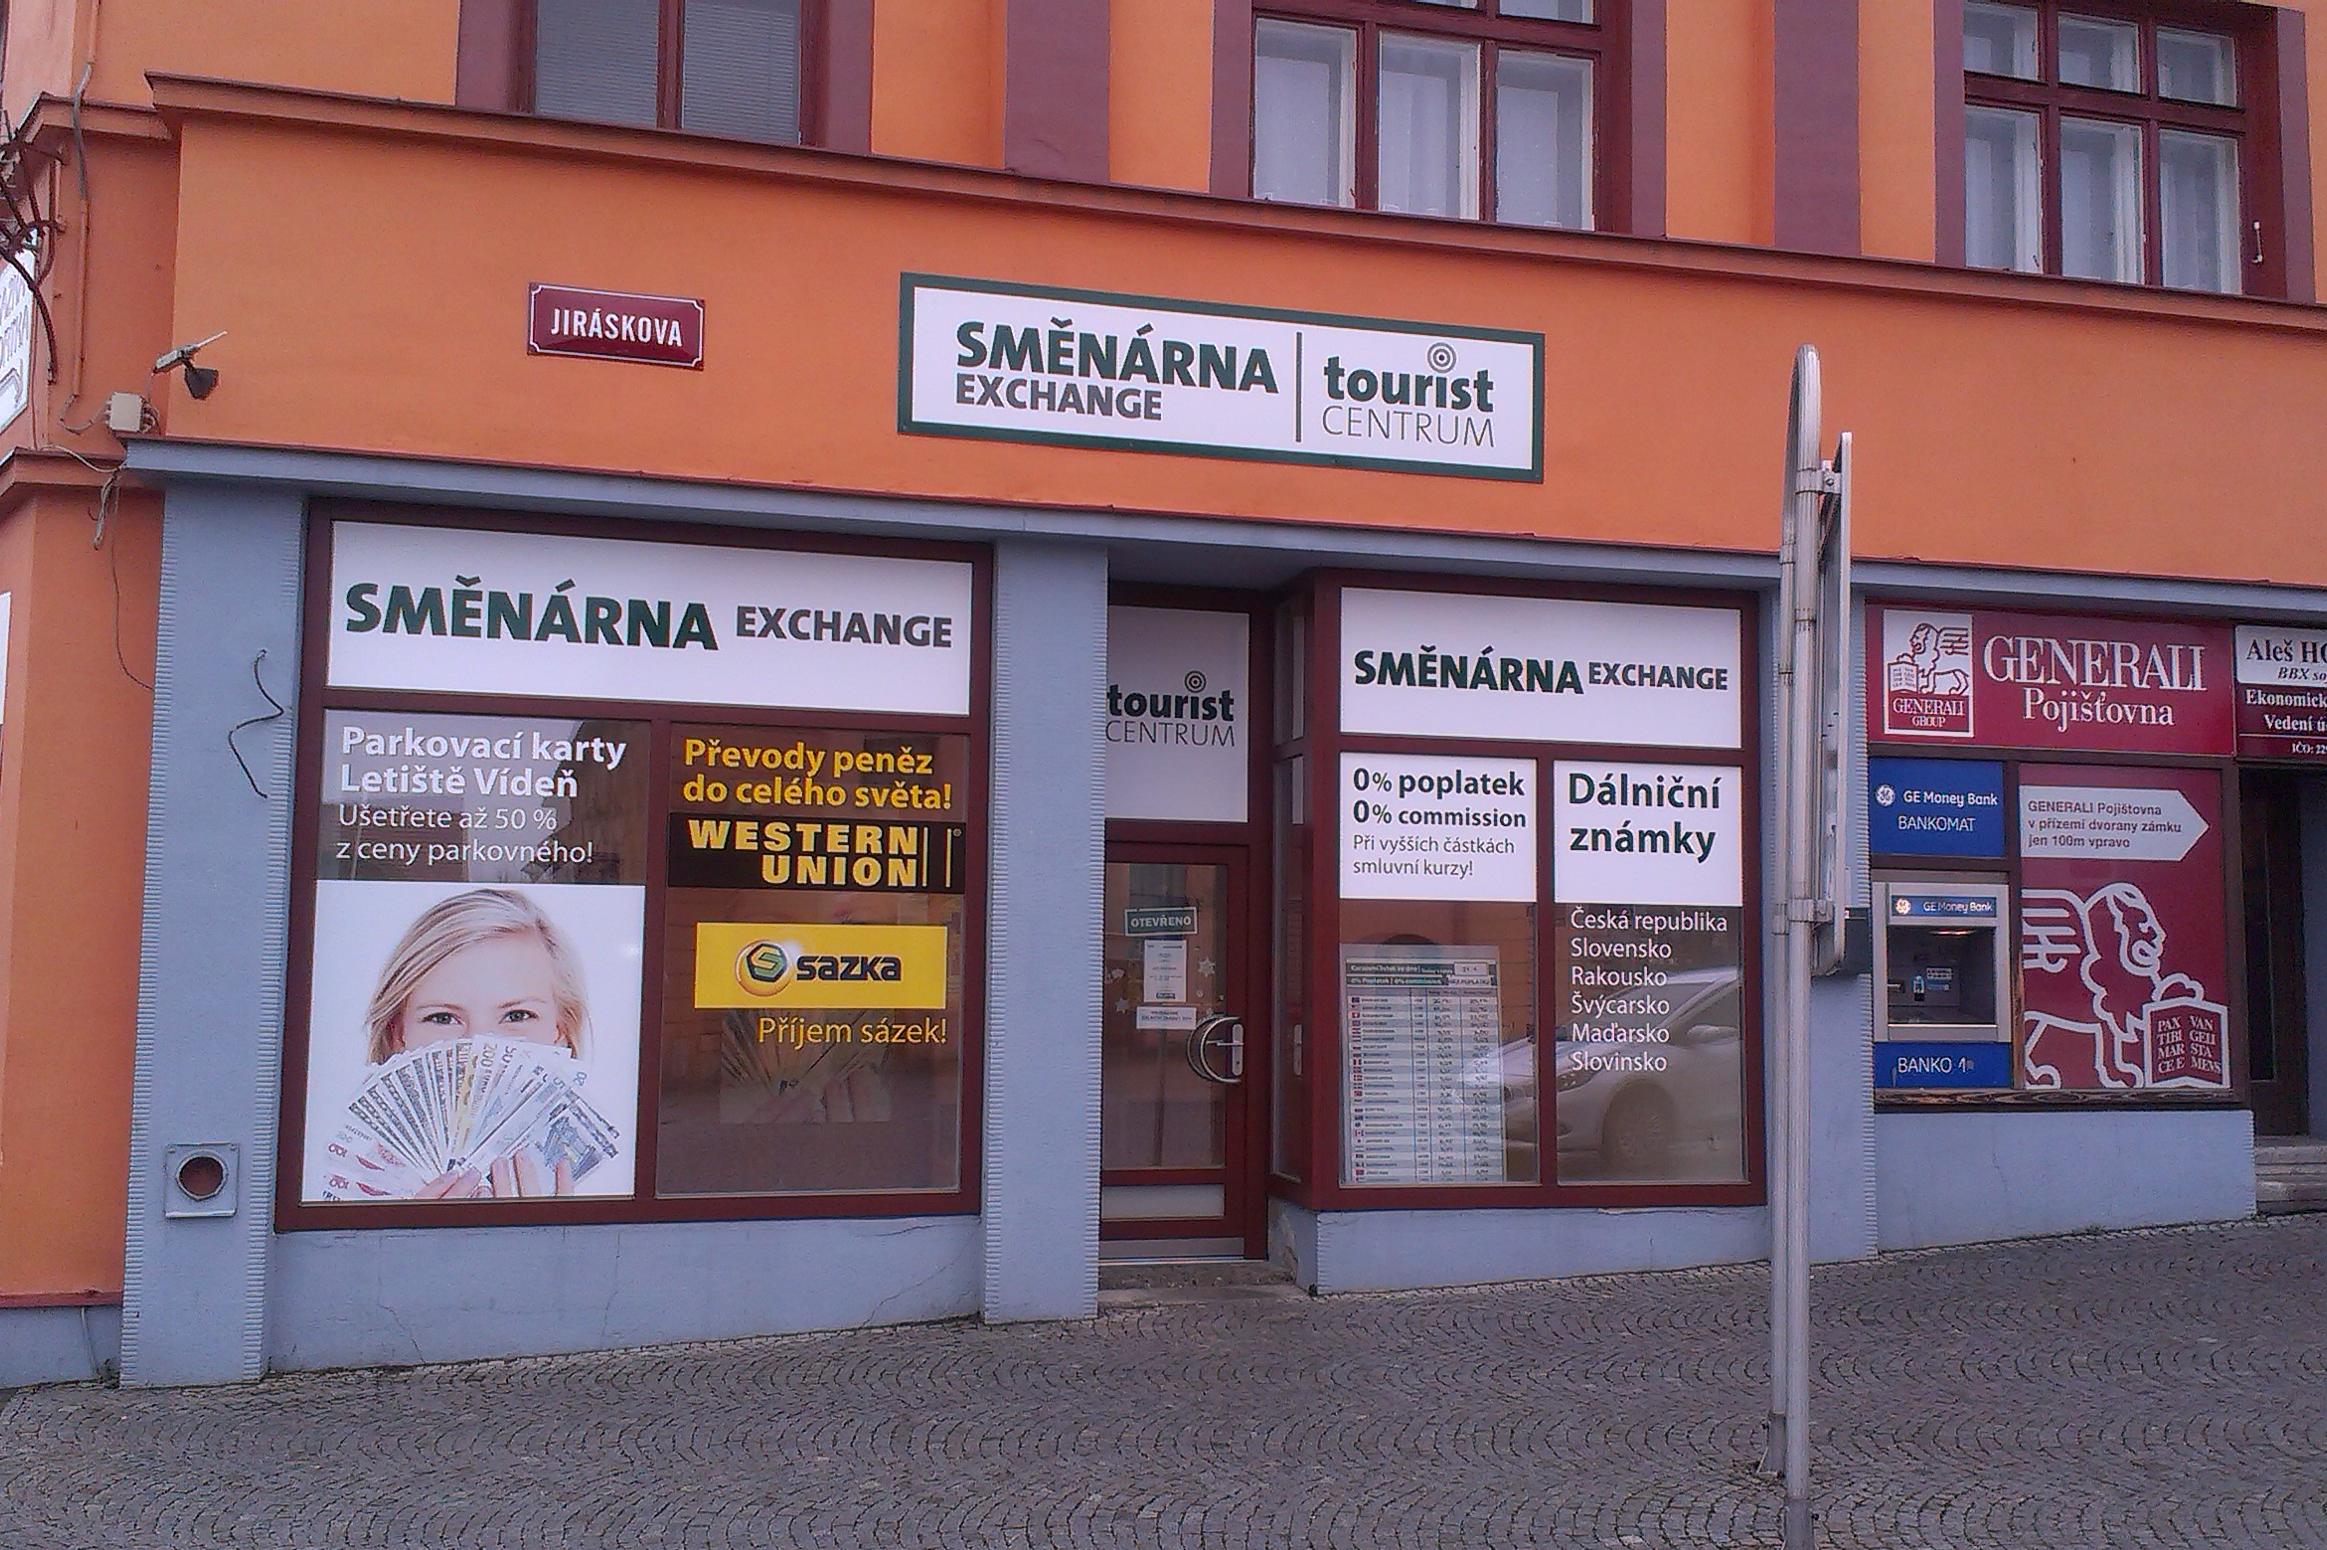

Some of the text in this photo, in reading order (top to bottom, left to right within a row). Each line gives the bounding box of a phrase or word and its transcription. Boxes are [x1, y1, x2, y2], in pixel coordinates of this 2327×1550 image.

[550, 308, 682, 347] JIRÁSKOVA
[955, 315, 1279, 394] SMĚNÁRNA
[1323, 343, 1495, 412] tourist
[955, 373, 1162, 421] EXCHANGE
[1323, 404, 1496, 448] CENTRUM
[345, 574, 953, 651] SMĚNÁRNA EXCHANGE
[1983, 635, 2207, 691] GENERALI
[2246, 639, 2294, 662] Aleš
[1354, 644, 1728, 695] SMĚNÁRNA EXCHANGE
[2278, 666, 2309, 680] BBX
[1107, 671, 1234, 721] tourist
[1893, 698, 1965, 716] GENERALI
[1912, 715, 1946, 727] GROUP
[2023, 688, 2175, 733] Pojišťovna
[2264, 714, 2313, 732] Vedení
[1105, 720, 1235, 747] CENTRUM
[341, 725, 627, 771] Parkovací karty
[684, 738, 933, 778] Převody peněz
[340, 764, 578, 798] Letiště Vídeň
[683, 774, 952, 810] do celého světa!
[1353, 768, 1525, 799] 0% poplatek
[1568, 772, 1722, 809] Dálniční
[1903, 790, 1998, 808] GE Money Bank
[2028, 800, 2093, 814] GENERALI
[338, 803, 558, 831] Ušetřete až 50 %
[1353, 800, 1526, 828] 0% commission
[1898, 815, 1976, 832] BANKOMAT
[2028, 820, 2036, 829] v
[2089, 819, 2138, 834] dvorany
[2141, 820, 2182, 833] zámku
[688, 819, 918, 855] WESTERN
[1353, 834, 1515, 857] Při vyšších částkách
[1569, 820, 1716, 864] známky
[2028, 835, 2130, 849] jen 100m vpravo
[335, 840, 593, 866] z ceny parkovného!
[762, 854, 918, 887] UNION
[1353, 858, 1473, 880] smluvní kurzy!
[1571, 905, 1728, 935] Česká republika
[1923, 901, 1993, 914] GE Money Bank
[1130, 914, 1192, 929] OTEVŘENO
[1571, 937, 1672, 958] Slovensko
[1571, 966, 1668, 986] Rakousko
[1571, 990, 1670, 1019] Švýcarsko
[758, 1017, 947, 1051] Příjem sázek!
[1571, 1022, 1670, 1043] Maďarsko
[2158, 1016, 2181, 1032] PAX
[2189, 1015, 2213, 1030] VAN
[1571, 1051, 1668, 1072] Slovinsko
[2158, 1043, 2185, 1059] MAR
[2189, 1042, 2212, 1058] STA
